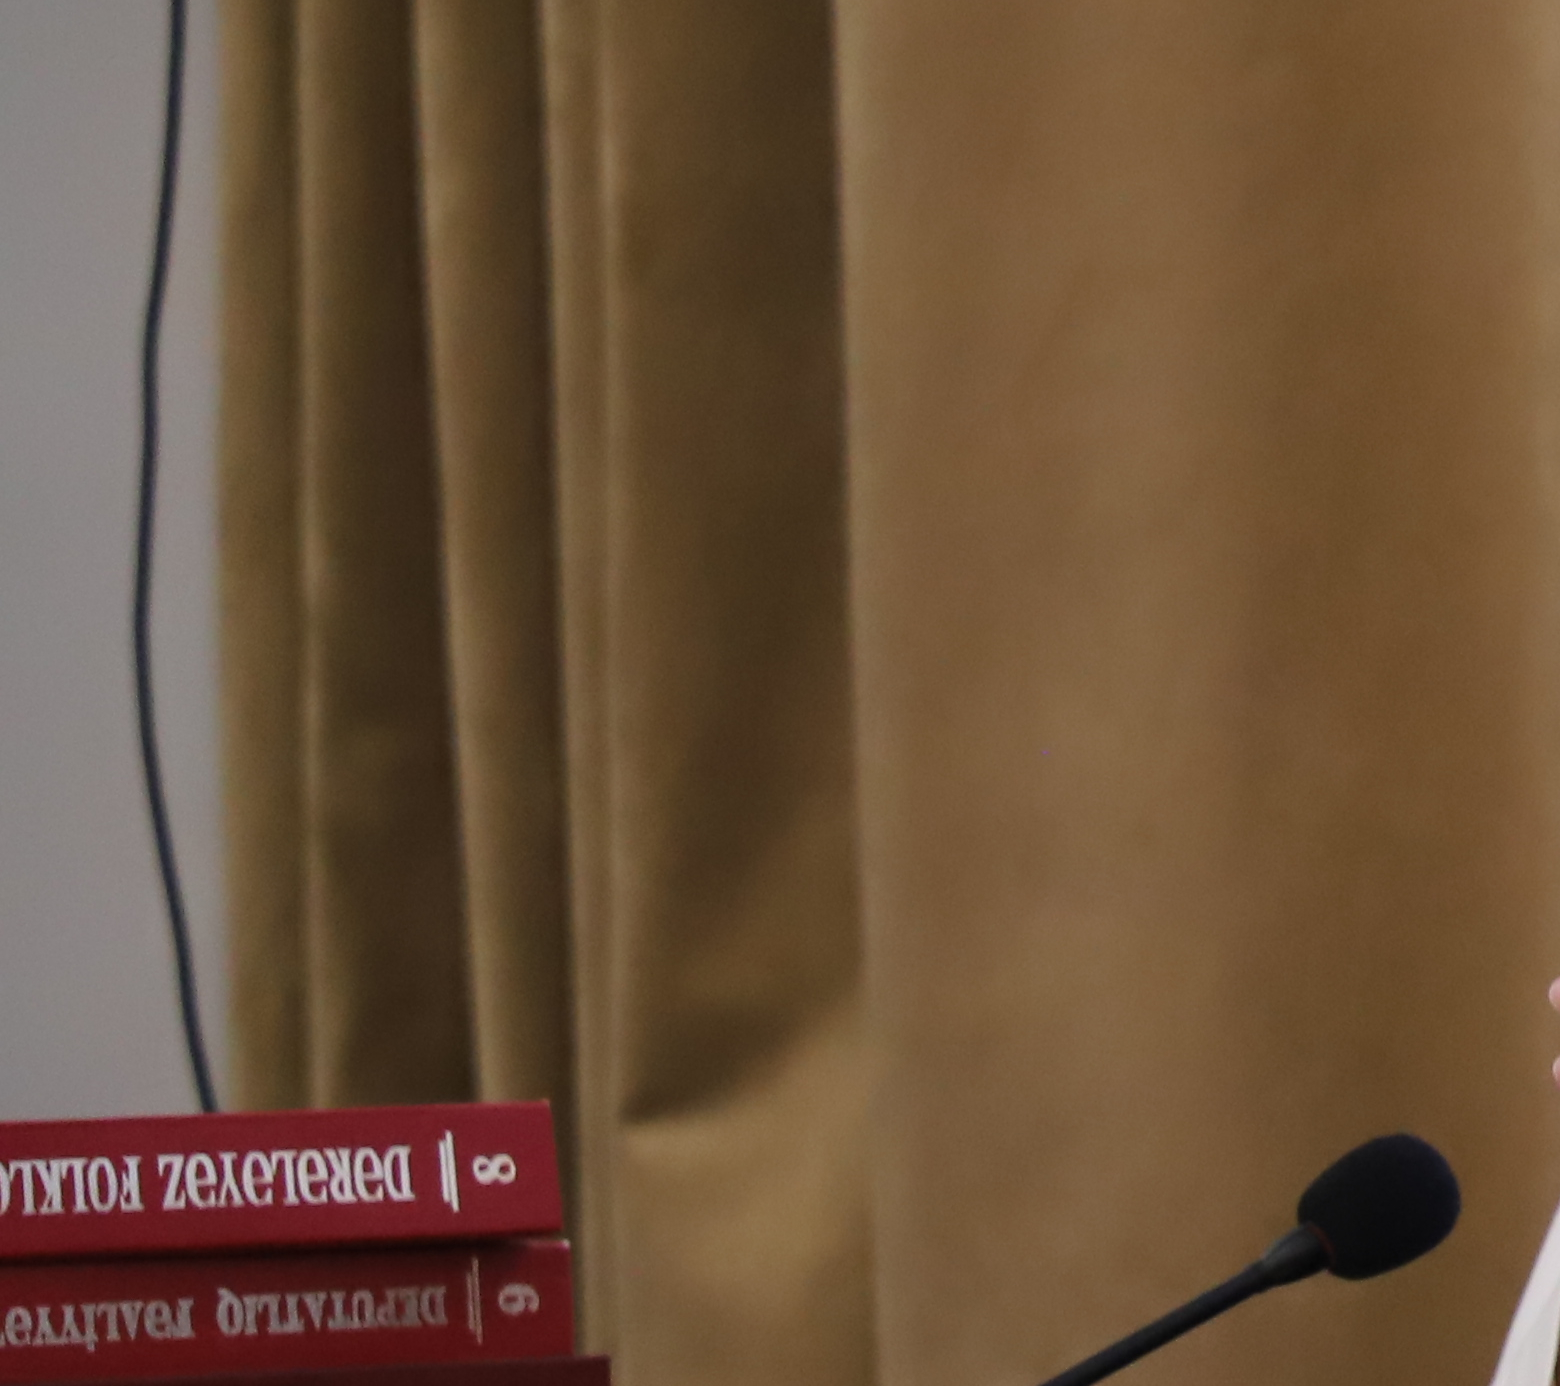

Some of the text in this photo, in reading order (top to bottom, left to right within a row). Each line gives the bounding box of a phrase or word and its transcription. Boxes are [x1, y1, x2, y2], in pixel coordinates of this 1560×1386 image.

[157, 1144, 415, 1211] DƏRƏLƏYƏZ
[472, 1153, 517, 1186] 8
[0, 1284, 449, 1353] DEPUTATLIQ FƏALİYYƏ
